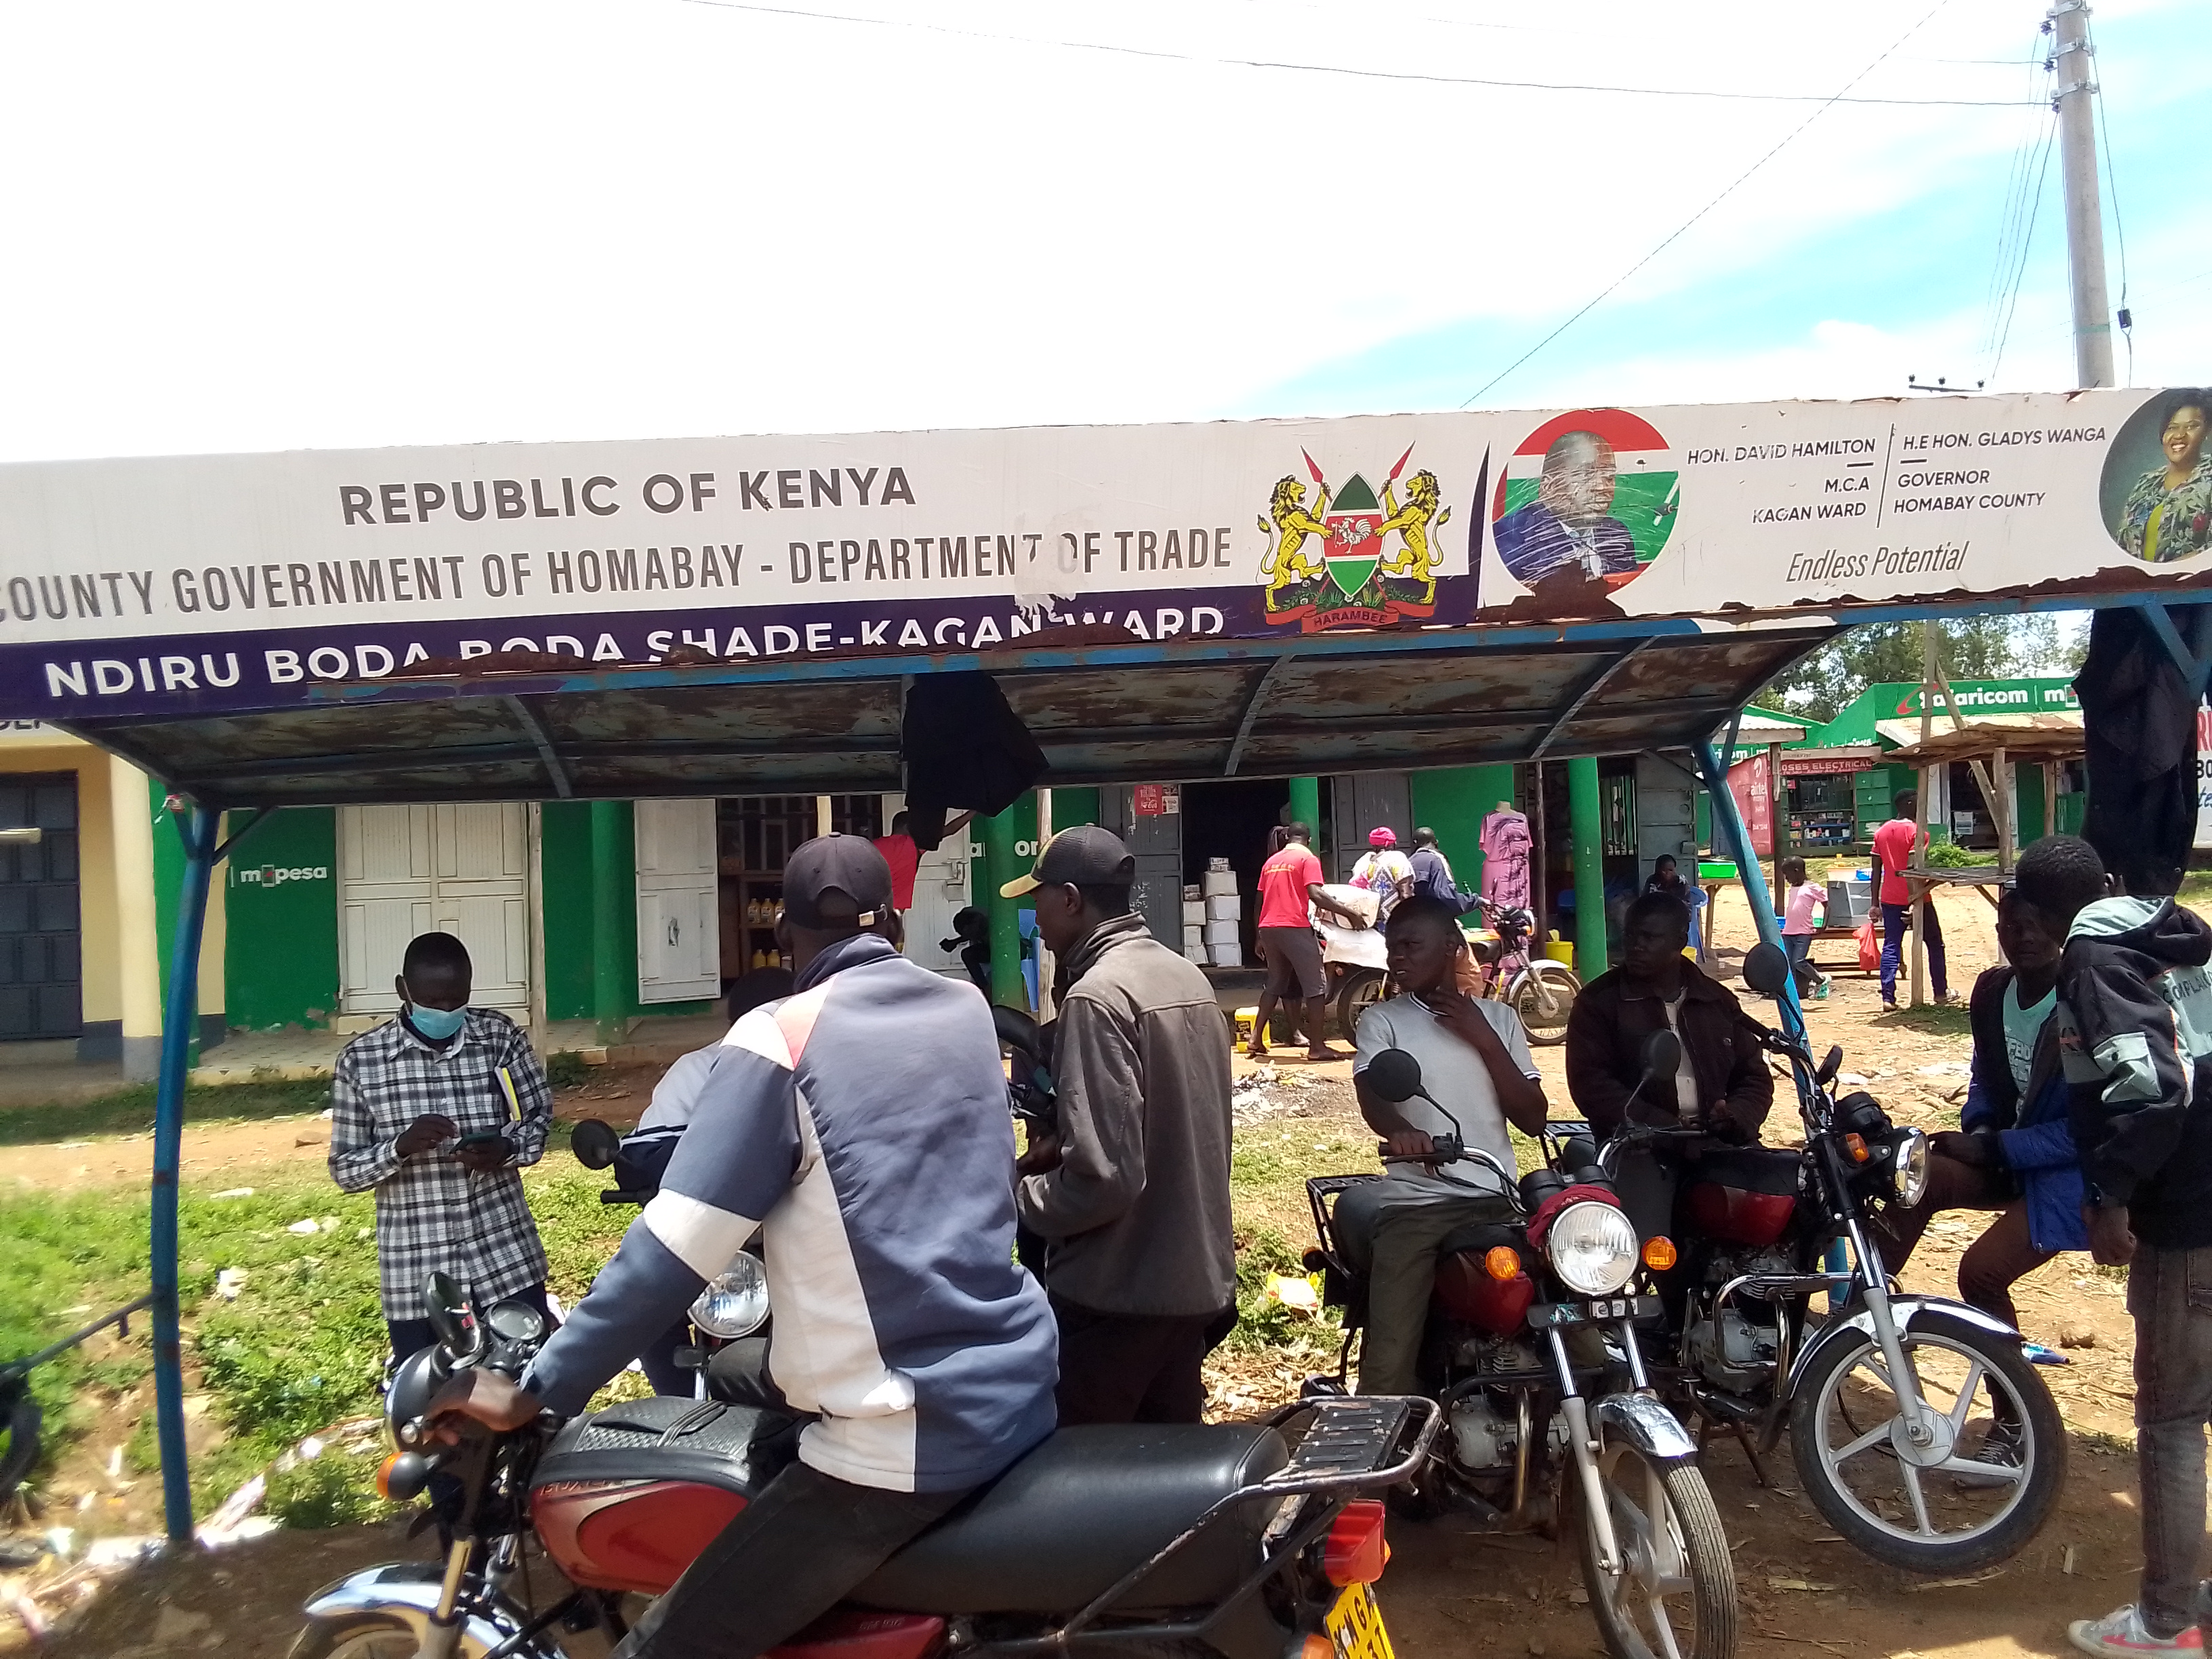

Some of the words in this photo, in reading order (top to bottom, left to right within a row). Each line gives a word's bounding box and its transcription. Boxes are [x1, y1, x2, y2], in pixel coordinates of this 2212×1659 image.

[1902, 435, 1929, 451] H.E
[1931, 432, 1973, 449] HON.
[1978, 430, 2042, 447] GLADYS
[2047, 427, 2106, 444] WANGA
[1687, 447, 1729, 464] HON.
[1734, 444, 1787, 462] DAVID
[1791, 438, 1876, 458] HAMILTON
[1824, 477, 1870, 493] M.C.A
[1898, 470, 1990, 488] GOVERNOR
[340, 474, 621, 526] REPUBLIC
[642, 471, 718, 515] OF
[738, 466, 917, 512] KENYA
[1893, 495, 1975, 514] HOMABAY
[1978, 492, 2046, 509] COUNTY
[1752, 505, 1812, 524] KAGAN
[1817, 502, 1867, 519] WARD
[1785, 548, 1868, 582] Endless
[1870, 540, 1969, 576] Potential
[0, 570, 153, 623] OUNTY
[171, 556, 465, 614] GOVERNMENT
[482, 552, 533, 598] OF
[547, 544, 743, 594] HOMABAY
[788, 533, 1043, 584] DEPARTMENT
[1057, 531, 1101, 573] OF
[1113, 527, 1231, 573] TRADE
[1314, 610, 1388, 626] HARAMBEE
[43, 653, 241, 697] NDIRU
[264, 642, 430, 684] BODA
[1919, 687, 2028, 710] aaricom
[1812, 760, 1872, 770] ELECTRICAL
[1750, 781, 1768, 796] airtel
